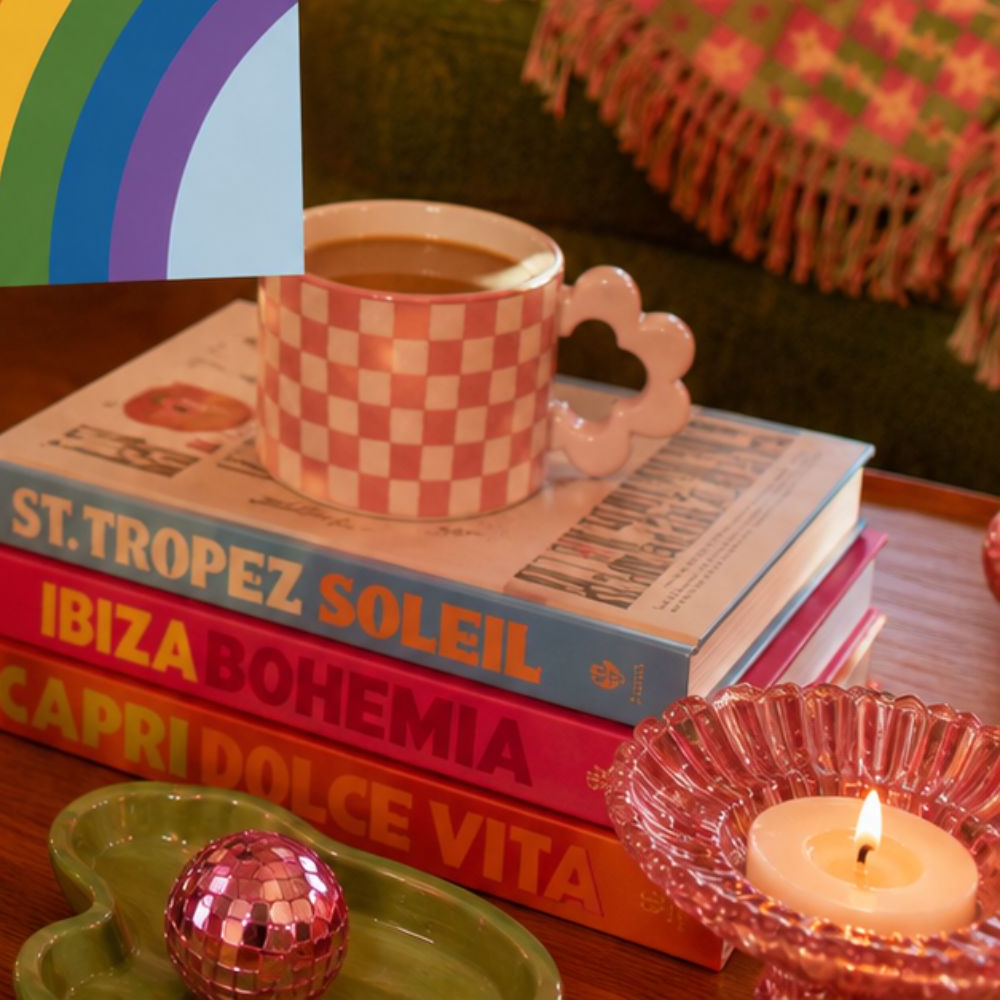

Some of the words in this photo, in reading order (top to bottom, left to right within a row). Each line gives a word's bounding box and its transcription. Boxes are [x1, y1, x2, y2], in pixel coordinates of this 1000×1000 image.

[40, 581, 198, 683] IBIZA
[204, 629, 534, 788] BOHEMIA
[317, 573, 542, 685] SOLEIL
[202, 727, 413, 853] DOLCE
[430, 801, 604, 916] VITA
